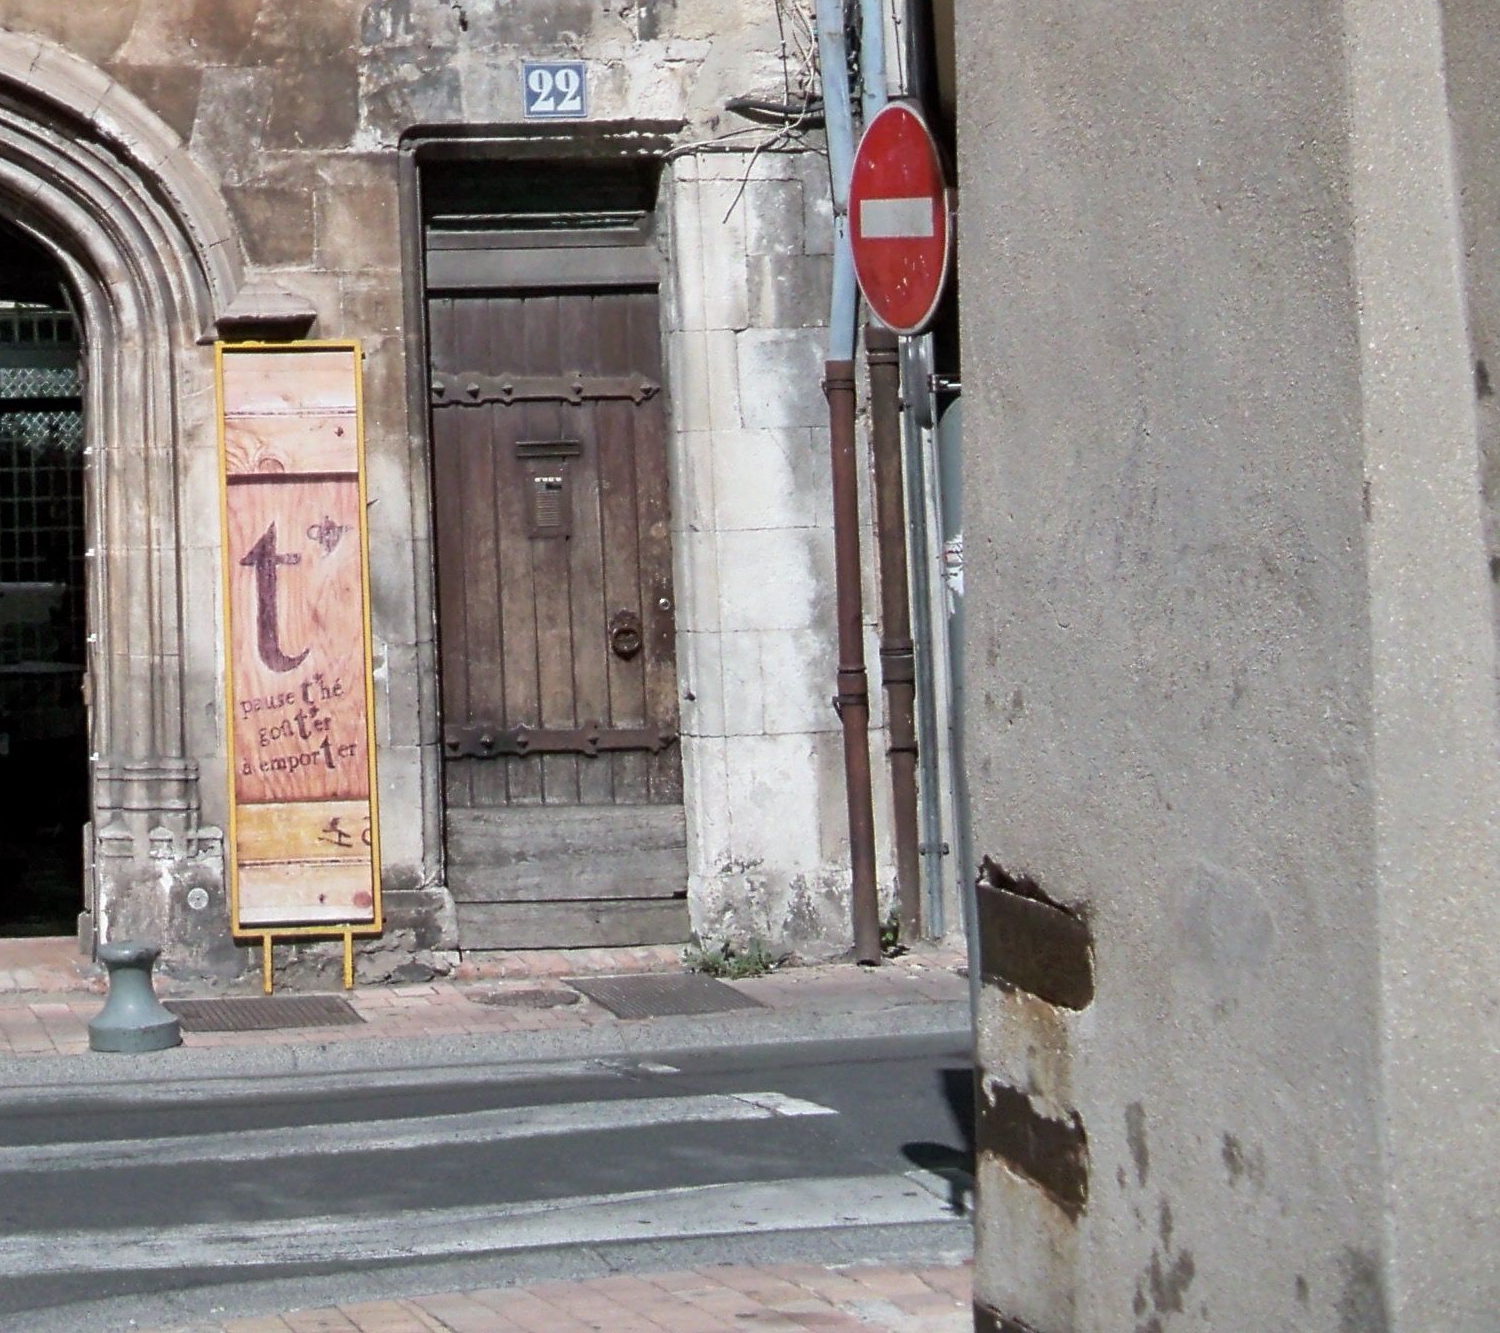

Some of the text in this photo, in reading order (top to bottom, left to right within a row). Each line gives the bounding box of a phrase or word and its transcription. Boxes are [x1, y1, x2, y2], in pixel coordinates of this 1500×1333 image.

[528, 68, 582, 112] 22
[240, 690, 295, 720] pause
[243, 734, 358, 776] à emporter
